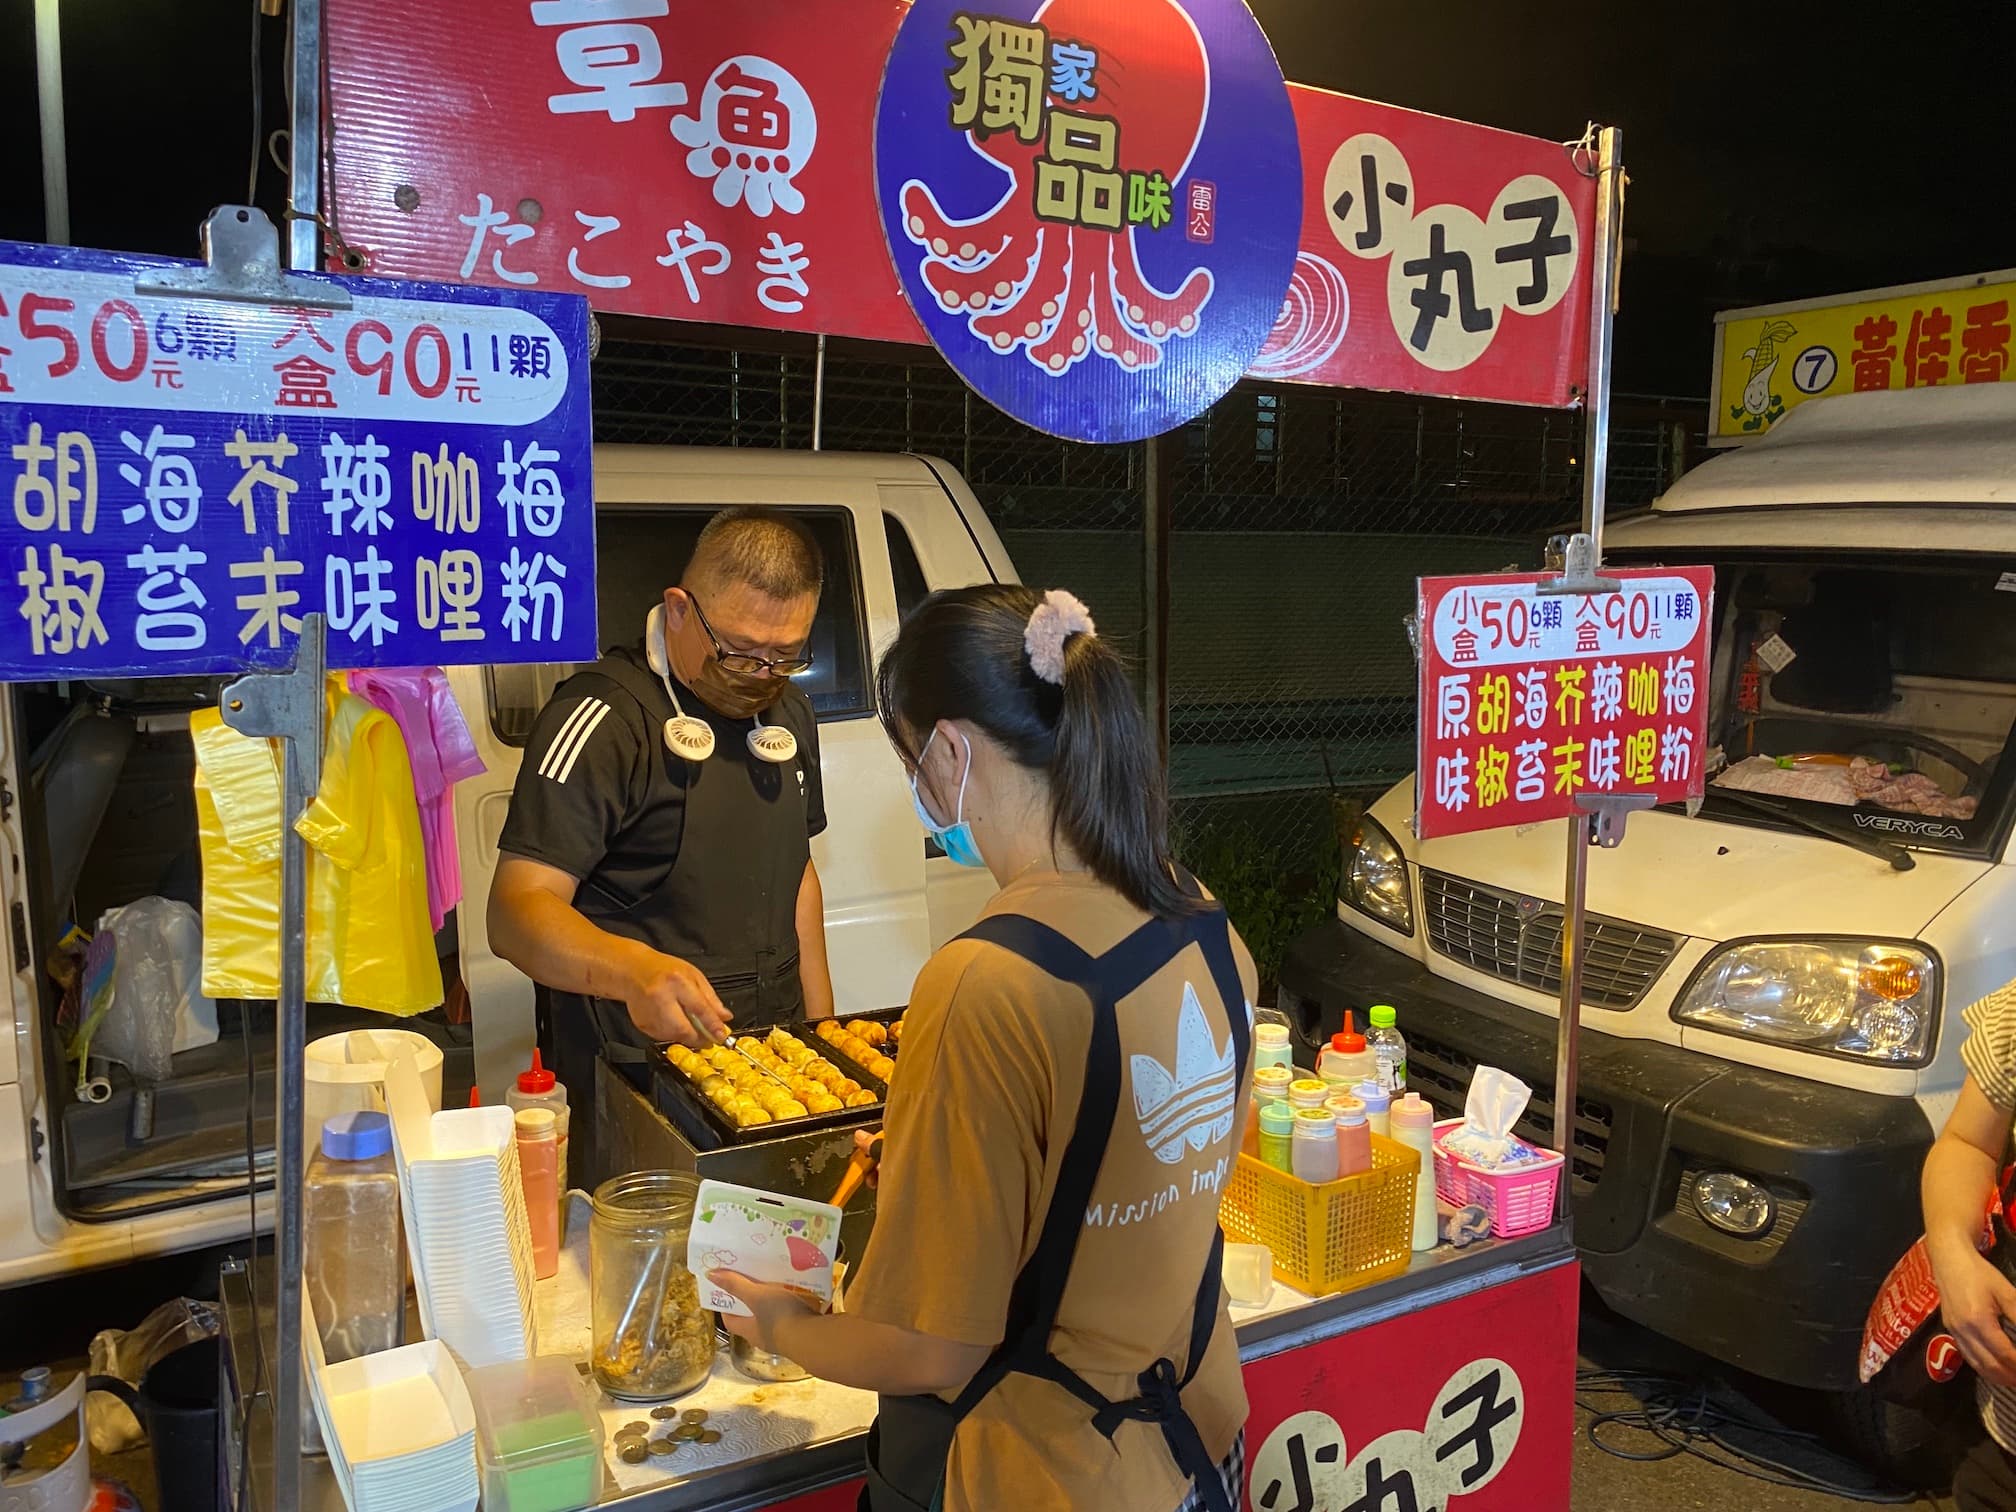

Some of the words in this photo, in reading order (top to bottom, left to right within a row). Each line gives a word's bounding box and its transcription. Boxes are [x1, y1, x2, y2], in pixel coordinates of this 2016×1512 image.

[949, 15, 1171, 229] 獨家品味
[1191, 184, 1212, 237] 雷公
[459, 193, 810, 313] たこやき
[1332, 154, 1572, 352] 小丸子
[1805, 354, 1827, 388] 7
[1853, 813, 1965, 840] VERYCA
[1086, 1184, 1179, 1227] Mission
